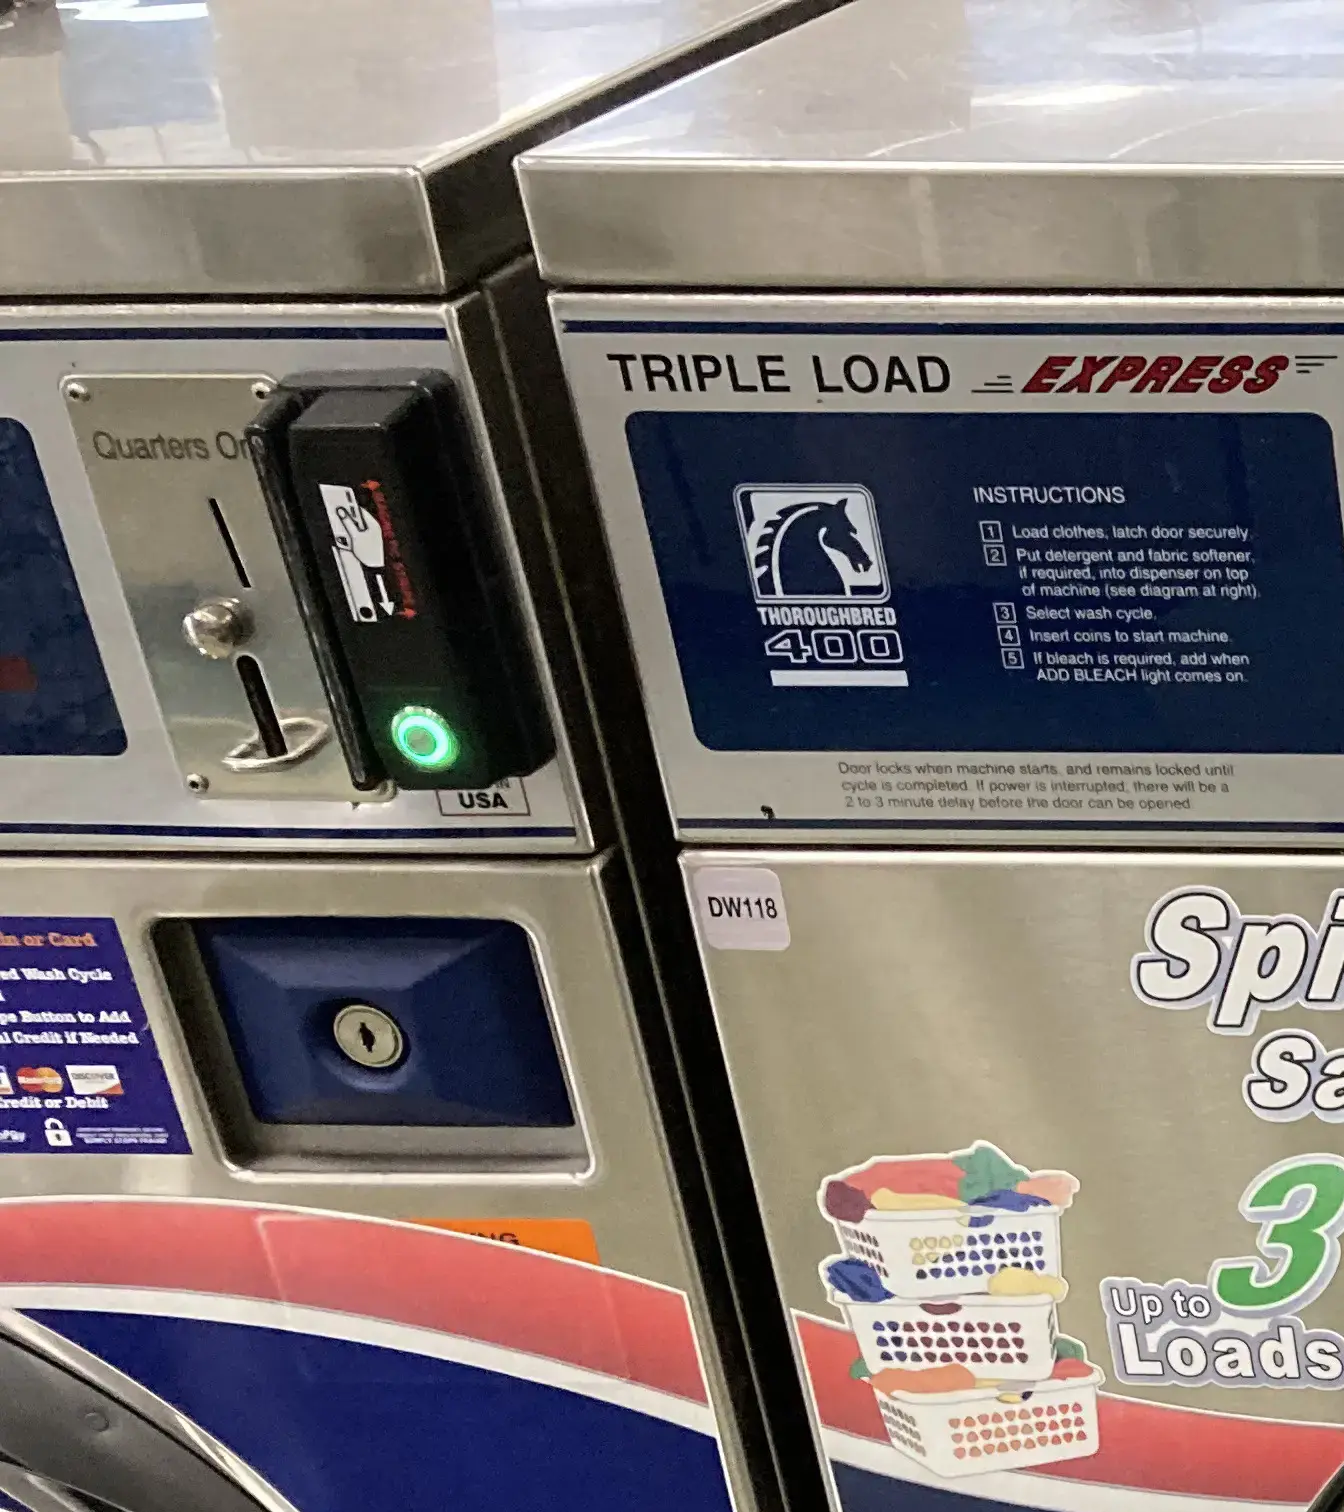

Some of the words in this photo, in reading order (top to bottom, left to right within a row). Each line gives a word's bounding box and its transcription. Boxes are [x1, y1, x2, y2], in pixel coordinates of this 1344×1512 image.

[607, 354, 790, 392] TRIPLE
[812, 355, 951, 393] LOAD
[1020, 355, 1290, 394] EXPRESS
[93, 431, 209, 460] Quarters
[973, 486, 1126, 504] INSTRUCTIONS
[1012, 526, 1048, 538] Load
[1053, 526, 1108, 540] clothes,
[1113, 526, 1147, 538] latch
[1151, 526, 1183, 538] door
[1016, 550, 1041, 562] Put
[1045, 550, 1111, 564] detergent
[1117, 550, 1144, 562] and
[1149, 550, 1188, 562] fabric
[757, 607, 896, 626] THOROUGHBRED
[1026, 607, 1070, 620] Select
[1075, 607, 1111, 620] wash
[1116, 607, 1156, 623] cycle.
[1030, 630, 1069, 642] Insert
[1074, 630, 1110, 642] coins
[1115, 631, 1128, 642] to
[1133, 631, 1164, 642] start
[764, 629, 903, 664] 400
[1033, 653, 1043, 665] If
[1047, 653, 1093, 665] bleach
[1098, 654, 1109, 665] is
[1181, 653, 1207, 665] add
[1211, 653, 1249, 665] when
[1037, 669, 1070, 681] ADD
[1074, 669, 1136, 682] BLEACH
[1141, 669, 1170, 684] light
[1175, 671, 1221, 682] comes
[458, 792, 508, 809] USA
[707, 896, 777, 920] DW118
[1111, 1287, 1163, 1321] Up
[1172, 1289, 1211, 1319] to
[1121, 1321, 1344, 1381] Loads
